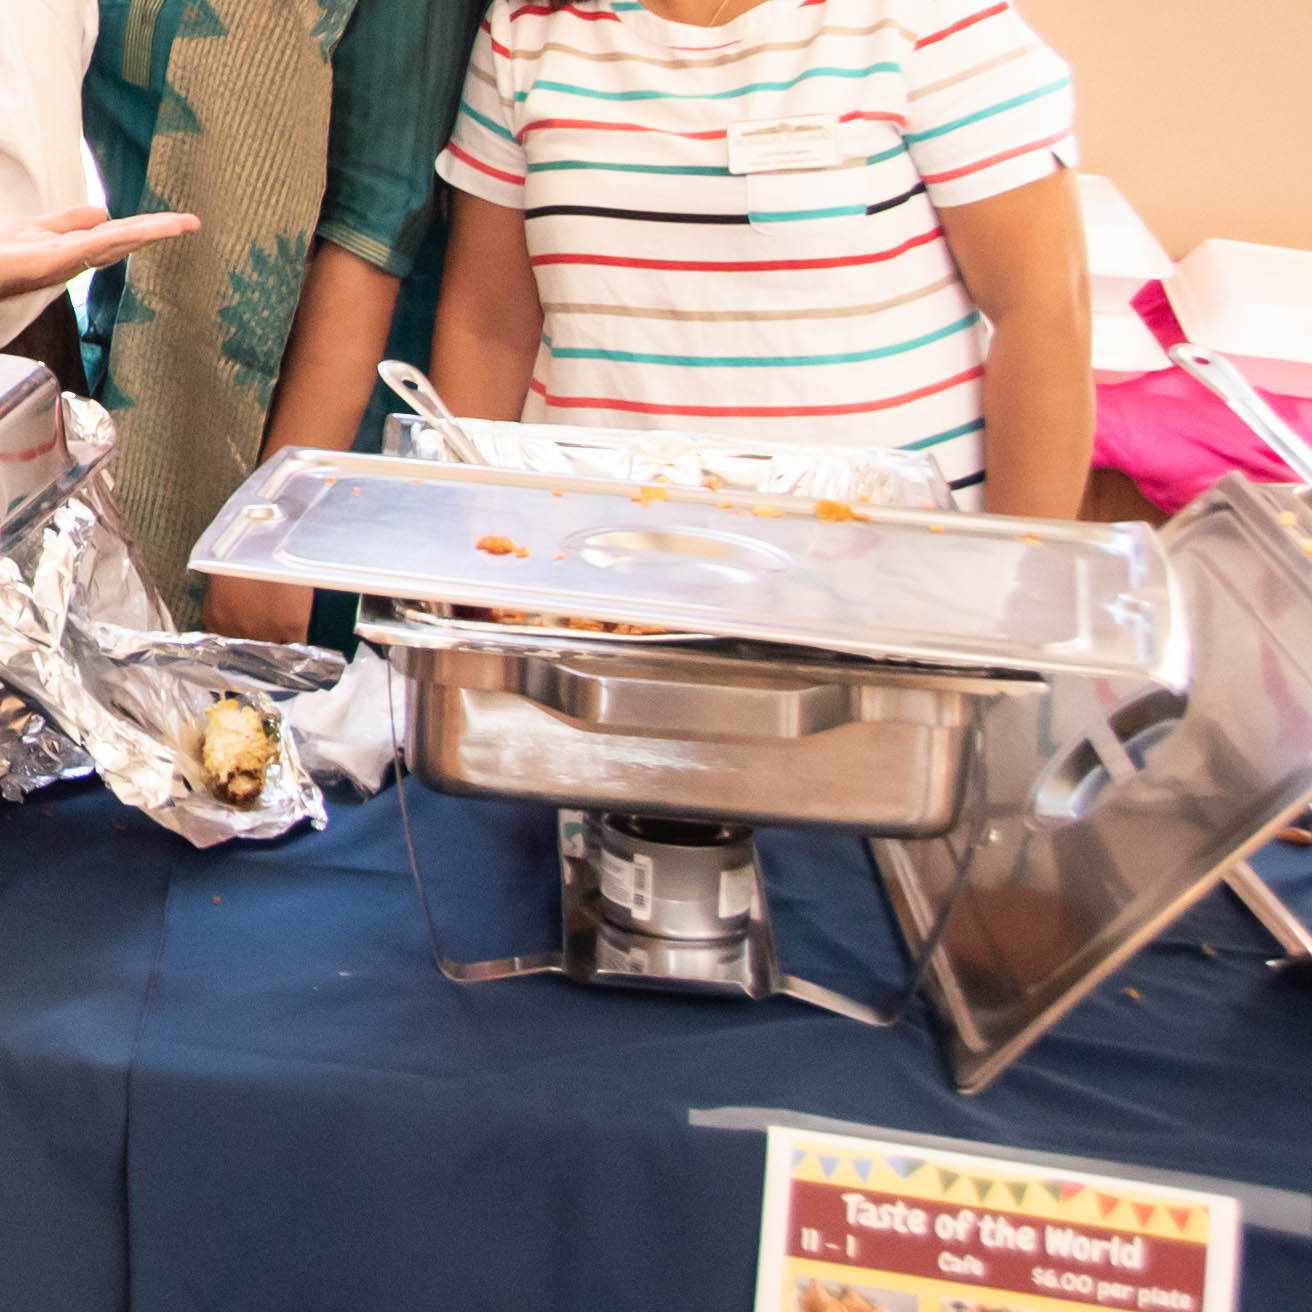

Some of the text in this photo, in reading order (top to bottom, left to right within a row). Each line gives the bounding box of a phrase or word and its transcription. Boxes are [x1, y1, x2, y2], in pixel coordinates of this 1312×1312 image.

[842, 1193, 1143, 1270] Taste of the World
[938, 1252, 985, 1278] Cafe
[1031, 1266, 1193, 1310] $6.00 per plate
